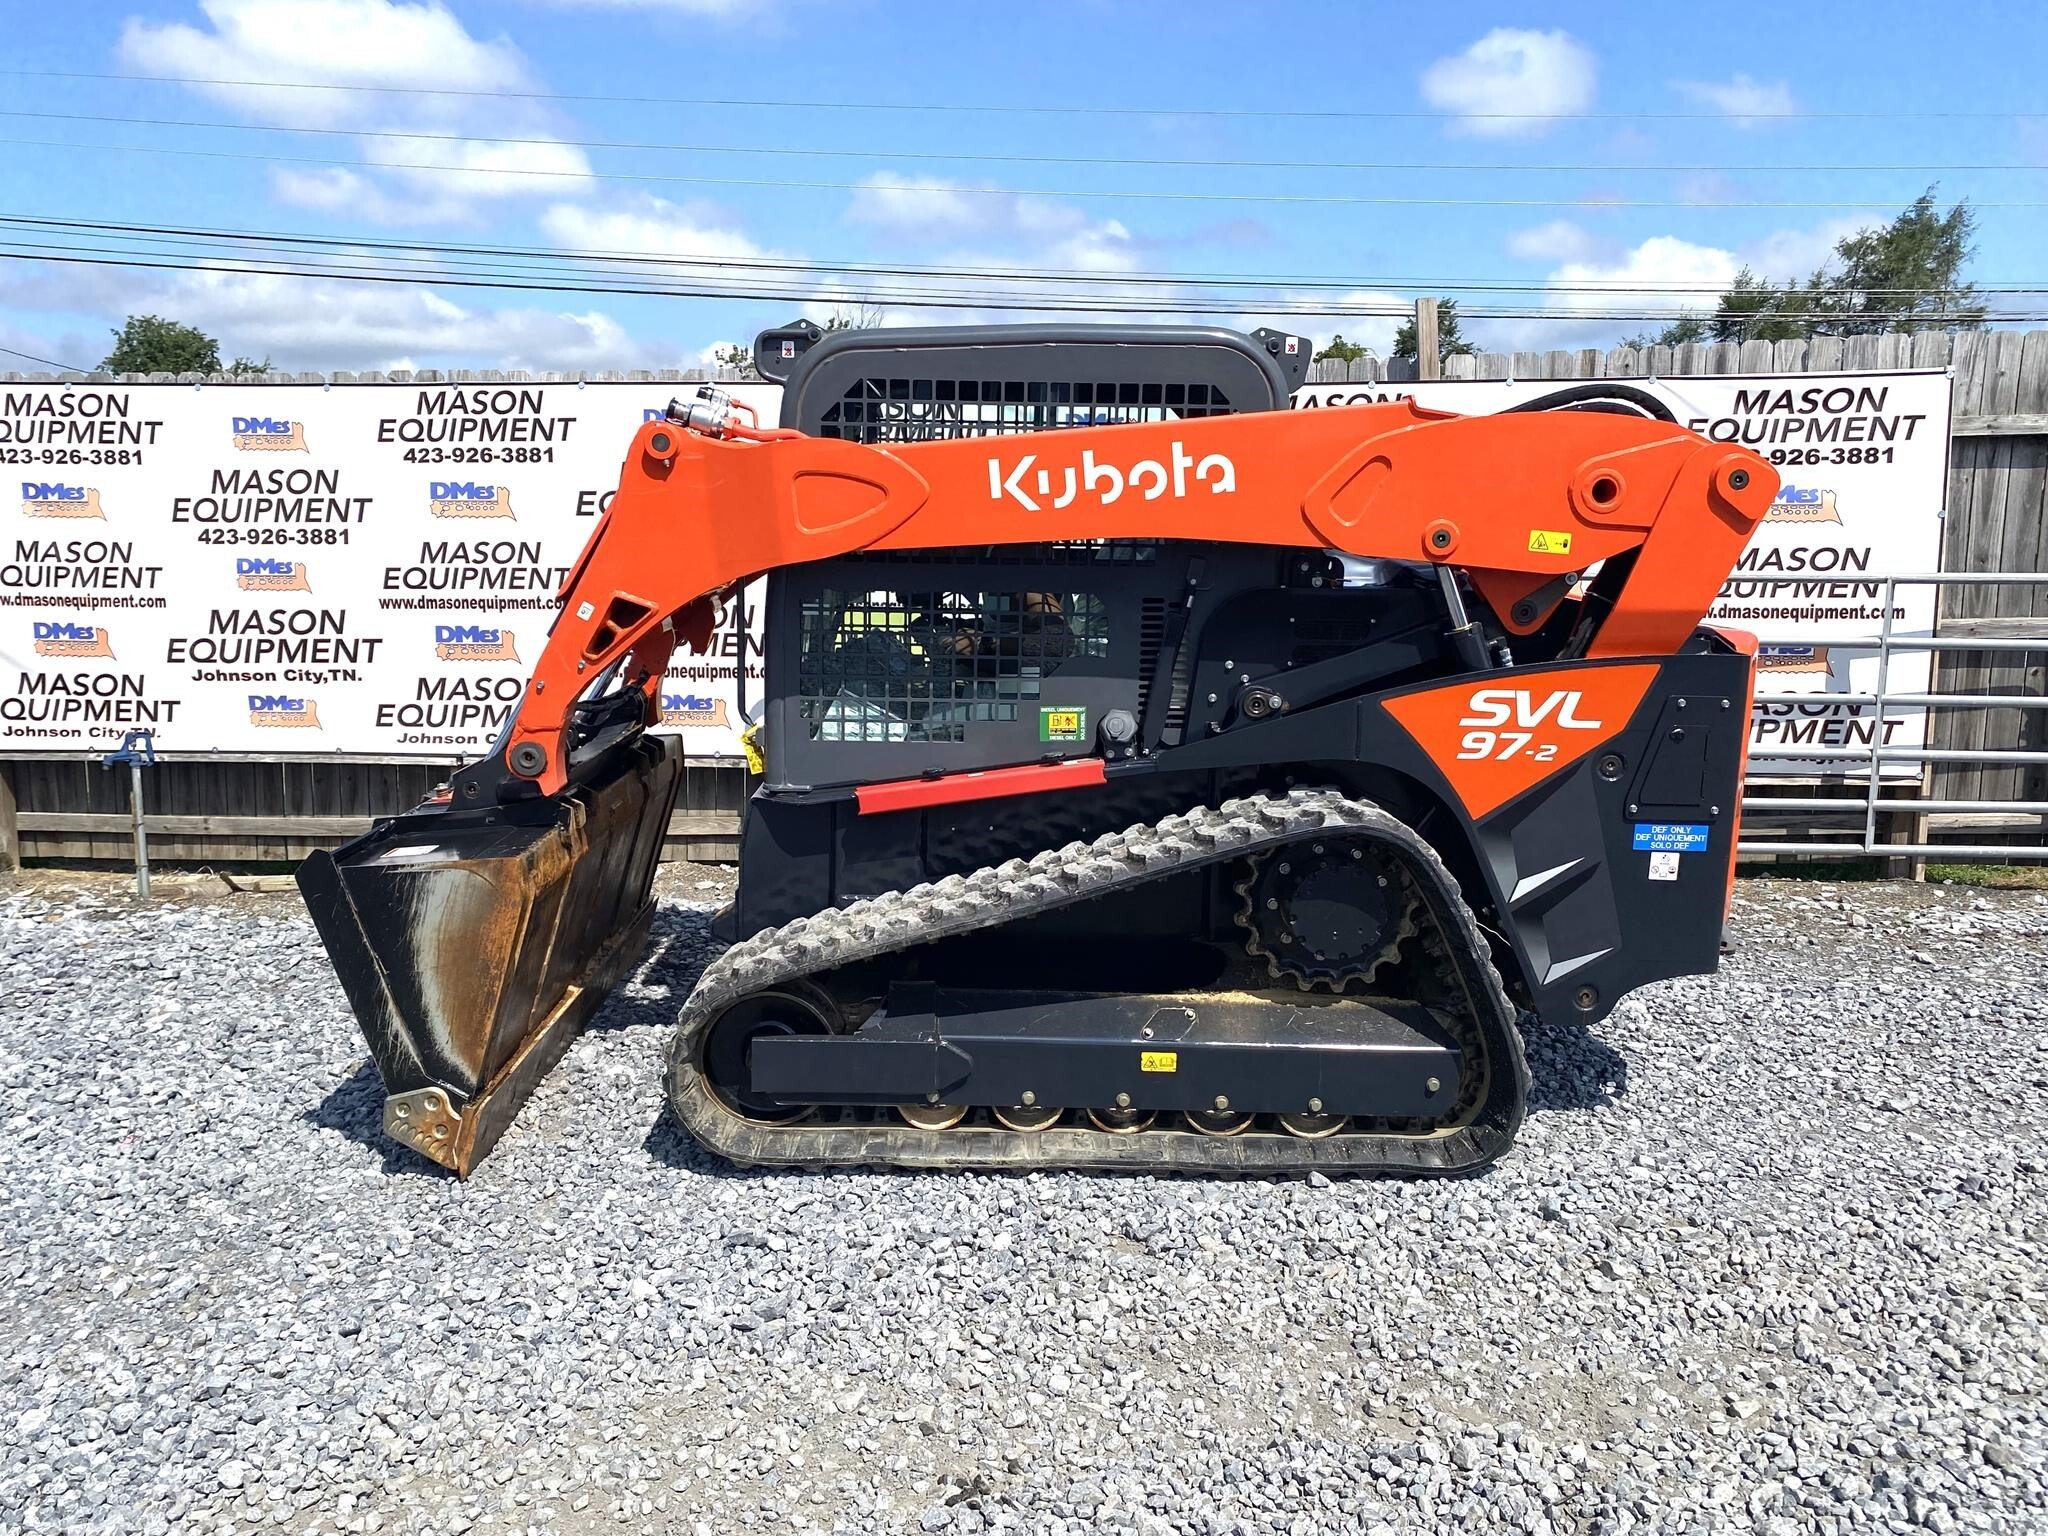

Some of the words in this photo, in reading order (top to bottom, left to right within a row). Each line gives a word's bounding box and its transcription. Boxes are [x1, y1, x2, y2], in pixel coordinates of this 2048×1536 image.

[5, 394, 129, 417] MASON
[416, 390, 543, 415] MASON
[1733, 387, 1888, 414] MASON
[0, 420, 163, 444] QUIPMENT
[378, 418, 576, 442] EQUIPMENT
[1688, 414, 1926, 443] EQUIPMENT
[404, 447, 553, 463] 423-926-3881
[212, 470, 338, 494] MASON
[989, 442, 1235, 510] Kubota
[172, 498, 372, 523] EQUIPMENT
[198, 529, 348, 544] 423-926-3881
[16, 541, 132, 563] MASON
[420, 542, 541, 564] MASON
[1736, 547, 1871, 571] MASON
[0, 565, 162, 588] QUIPMENT
[383, 567, 571, 590] EQUIPMENT
[0, 593, 166, 610] w.dmasonequipment.com
[378, 595, 564, 612] www.dmasonequipment.co
[209, 610, 345, 635] MASON
[167, 638, 383, 663] EQUIPMENT
[18, 673, 144, 696] MASON
[192, 670, 276, 681] Johnson
[284, 670, 362, 684] City,TN.
[416, 677, 530, 701] MASO
[1, 698, 180, 722] QUIPMENT
[1460, 690, 1601, 728] SVL
[3, 726, 81, 737] Johnson
[397, 733, 477, 743] Johnson
[1457, 732, 1557, 760] 97-2
[1653, 834, 1706, 842] UNIQUEMENT
[1670, 826, 1691, 834] ONLY
